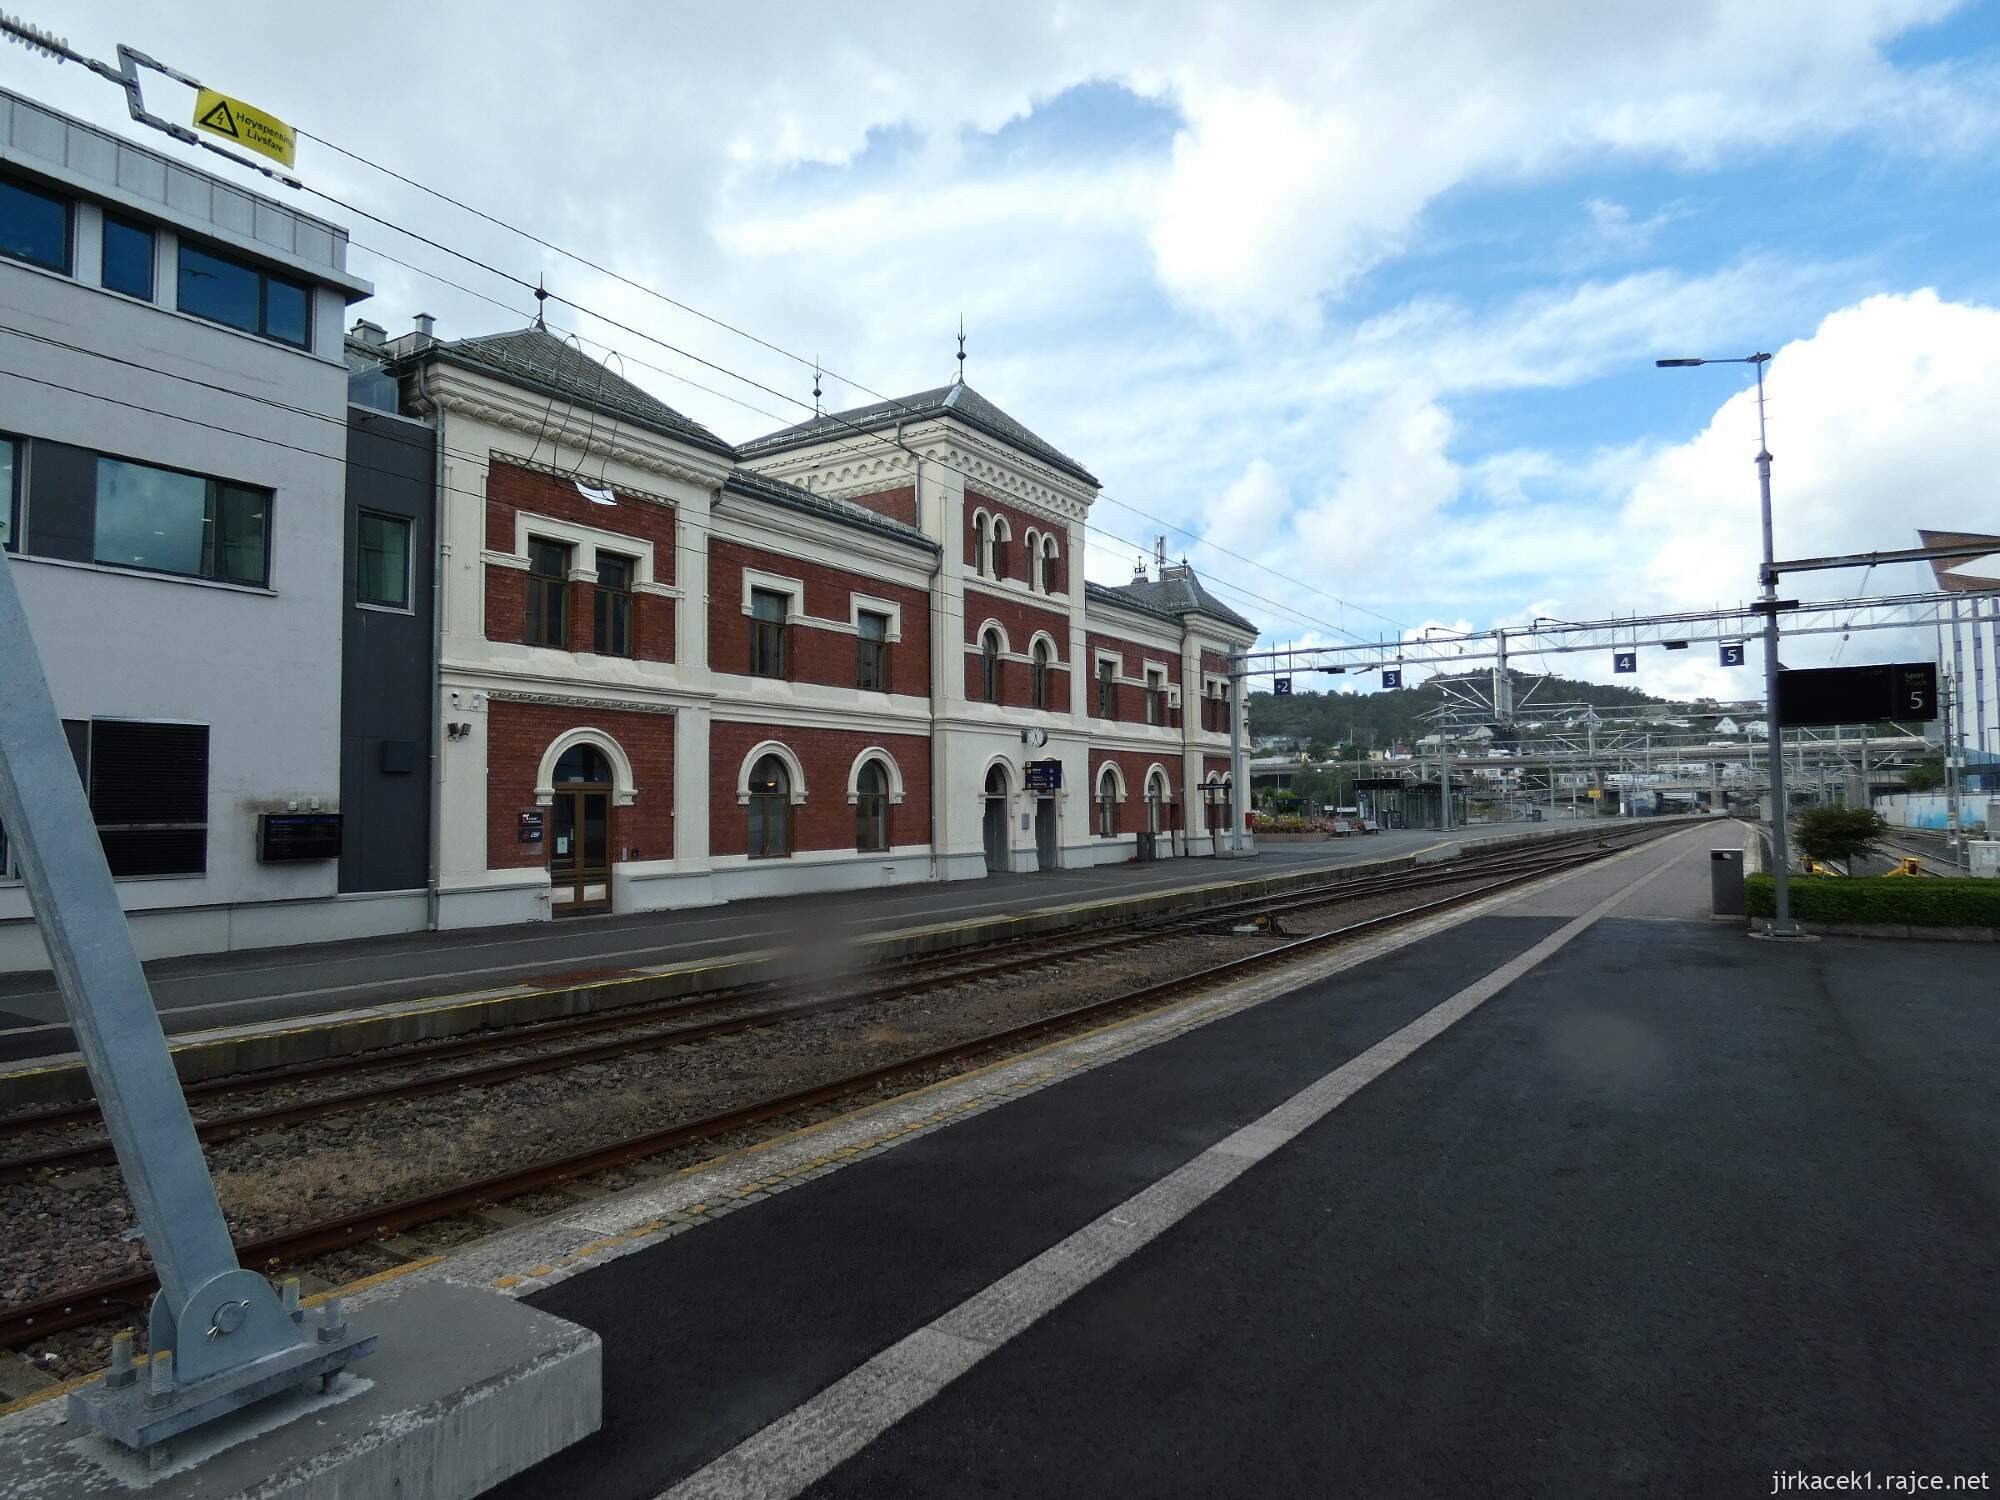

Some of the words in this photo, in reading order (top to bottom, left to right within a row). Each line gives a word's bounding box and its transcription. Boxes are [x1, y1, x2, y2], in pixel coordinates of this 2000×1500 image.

[247, 129, 284, 153] Livsfare
[1620, 656, 1630, 669] 4
[1727, 649, 1737, 663] 5
[1388, 673, 1396, 685] 3
[1281, 681, 1289, 692] 2
[1910, 691, 1923, 709] 5
